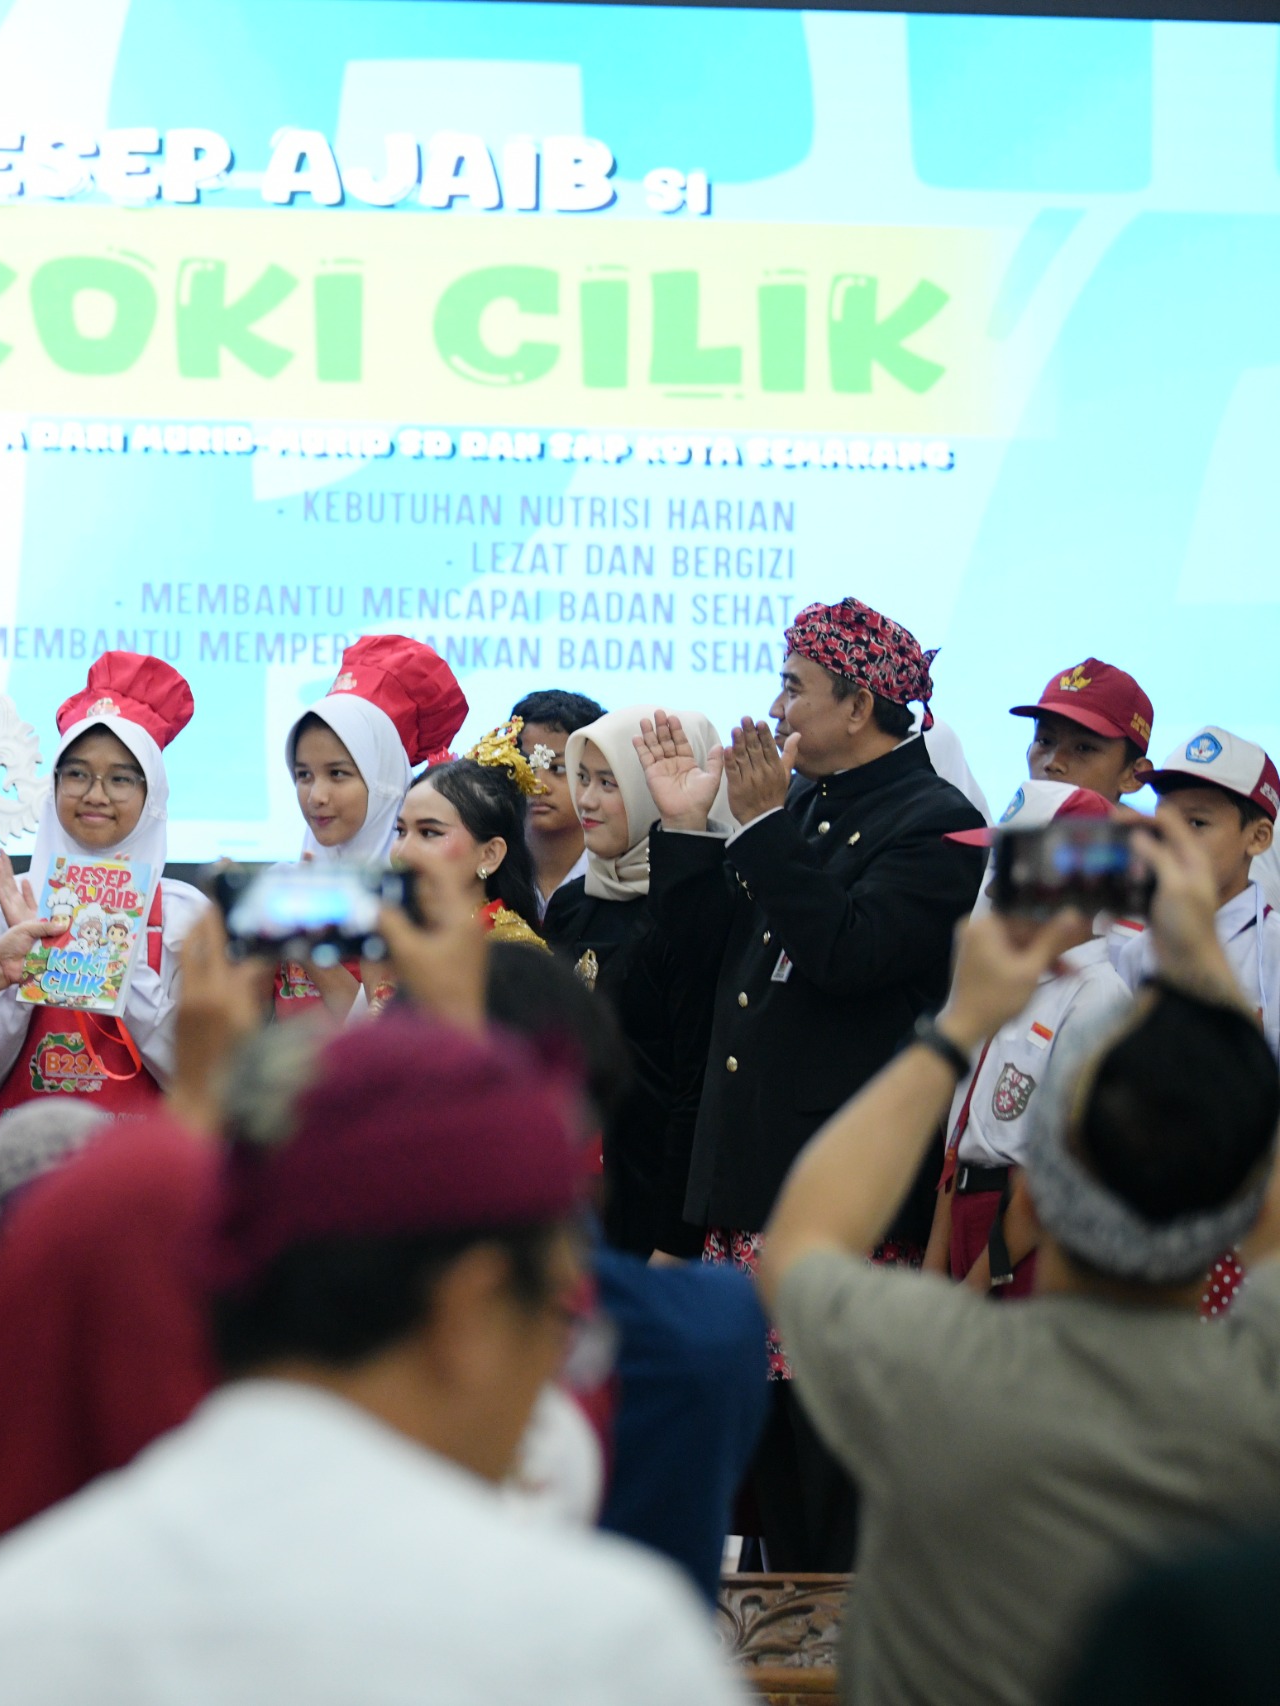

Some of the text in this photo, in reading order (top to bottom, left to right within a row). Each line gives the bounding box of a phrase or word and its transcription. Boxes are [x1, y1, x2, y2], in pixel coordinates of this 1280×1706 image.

[261, 126, 621, 213] AJAIB
[642, 168, 713, 216] SI
[432, 262, 951, 400] CILIK
[31, 422, 130, 456] DARI
[398, 428, 458, 462] SD
[459, 430, 548, 464] DAN
[549, 432, 634, 466] SMP
[637, 434, 745, 468] KOTA
[746, 437, 956, 473] SEMARANG
[303, 490, 796, 532] KEBUTUHAN NUTRISI HARIAN
[472, 541, 795, 580] LEZAT DAN BERGIZI
[141, 582, 795, 627] MEMBANTU MENCAPAI BADAN SEHAT
[199, 630, 541, 670] MEMPERANKAN
[558, 637, 674, 672] BADAN
[66, 865, 132, 889] RESEP
[75, 884, 139, 910] AJAIB
[41, 970, 107, 996] CILIK
[47, 949, 109, 977] KOKI
